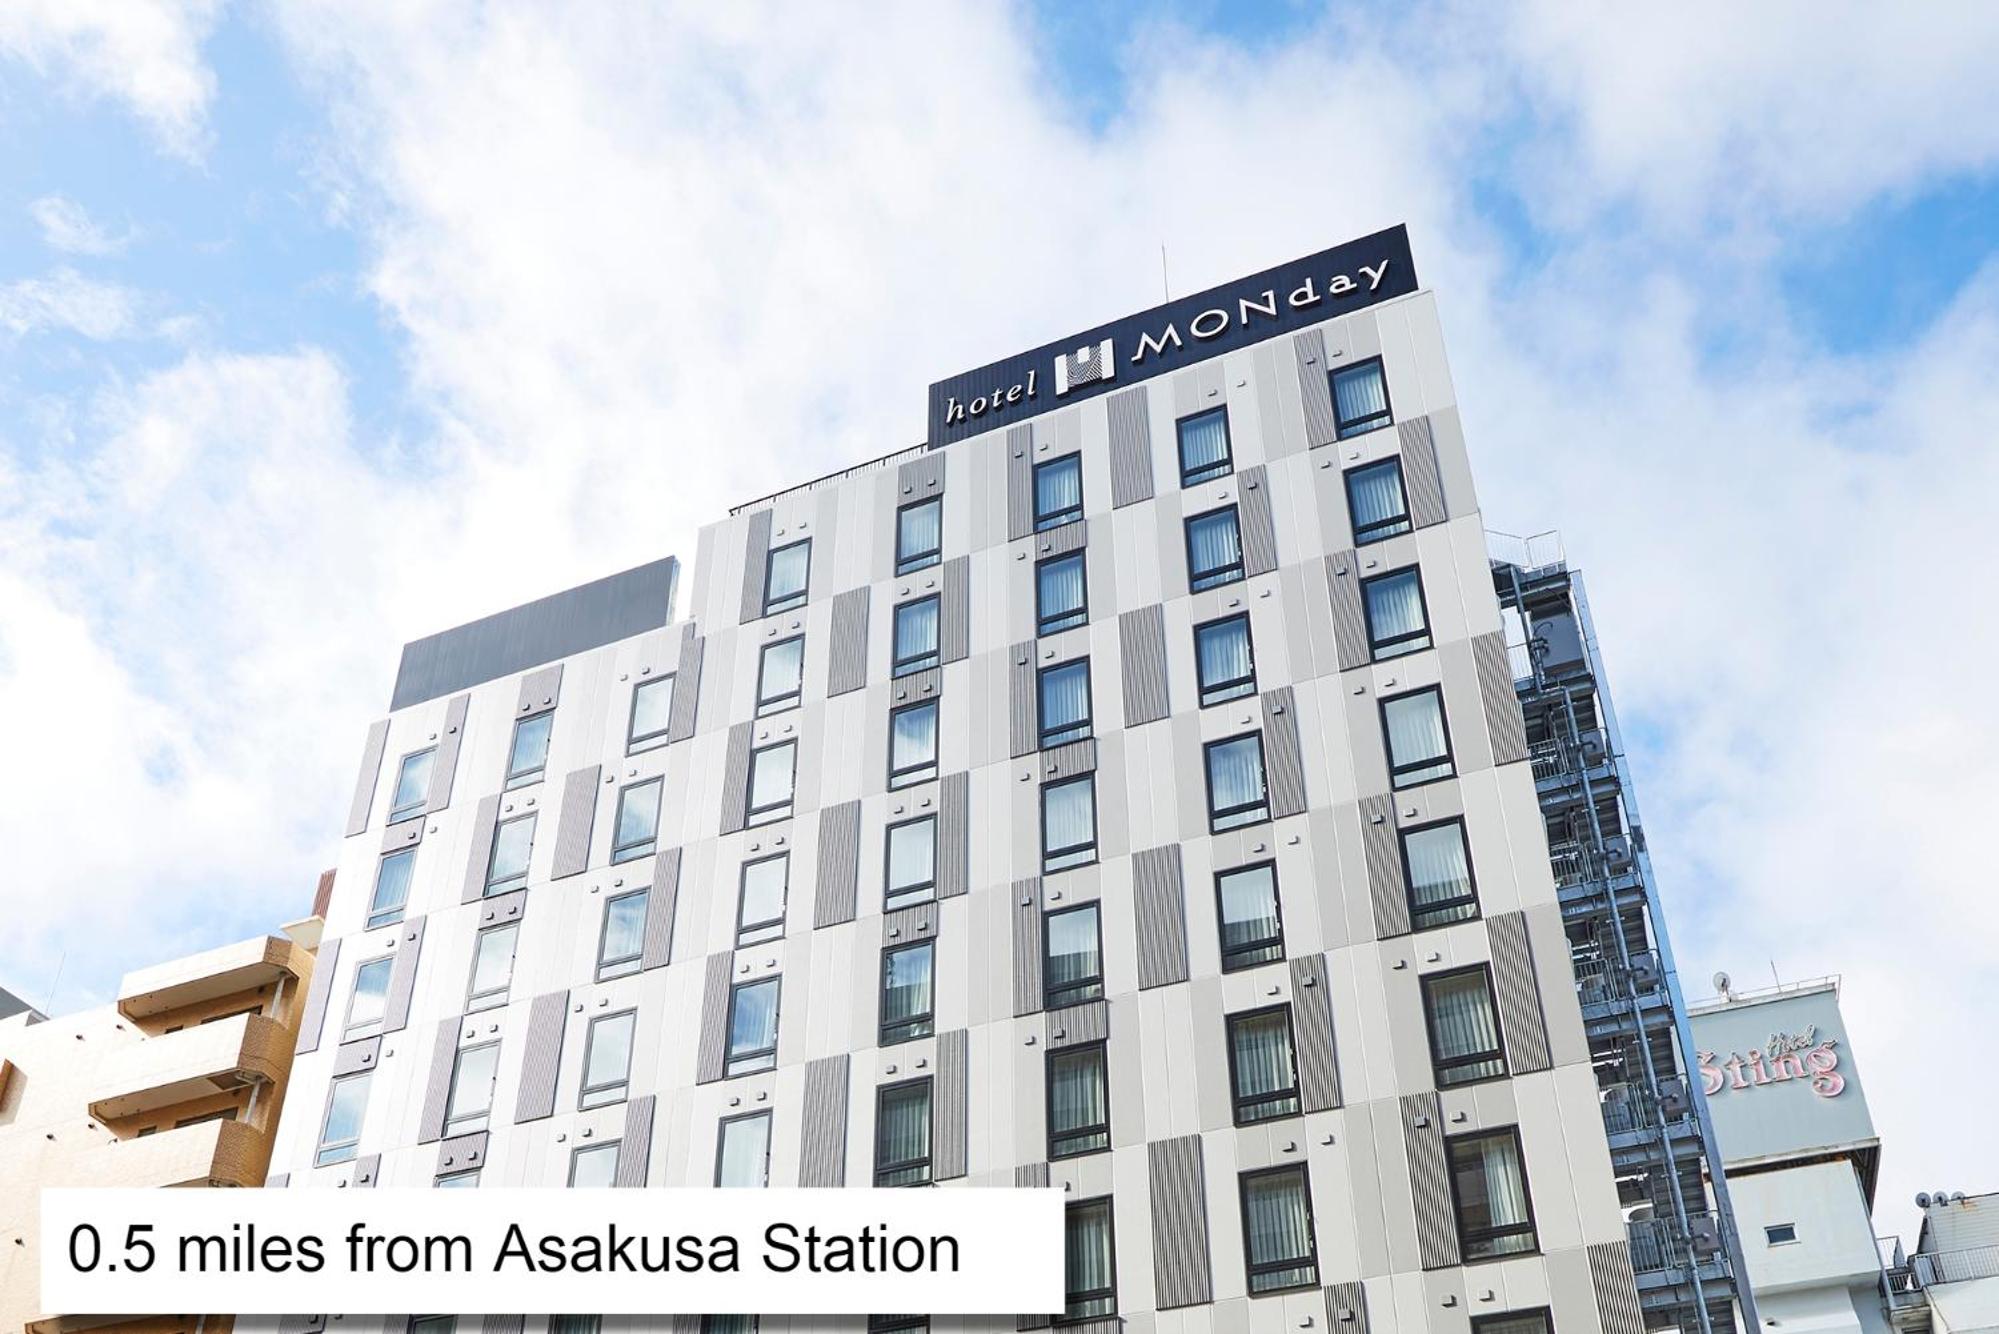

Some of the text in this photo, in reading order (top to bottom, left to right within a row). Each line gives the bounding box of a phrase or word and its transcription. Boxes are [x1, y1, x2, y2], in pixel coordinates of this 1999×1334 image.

[946, 369, 1036, 423] hotel
[1131, 259, 1389, 362] MONday
[1697, 1039, 1845, 1098] Sting
